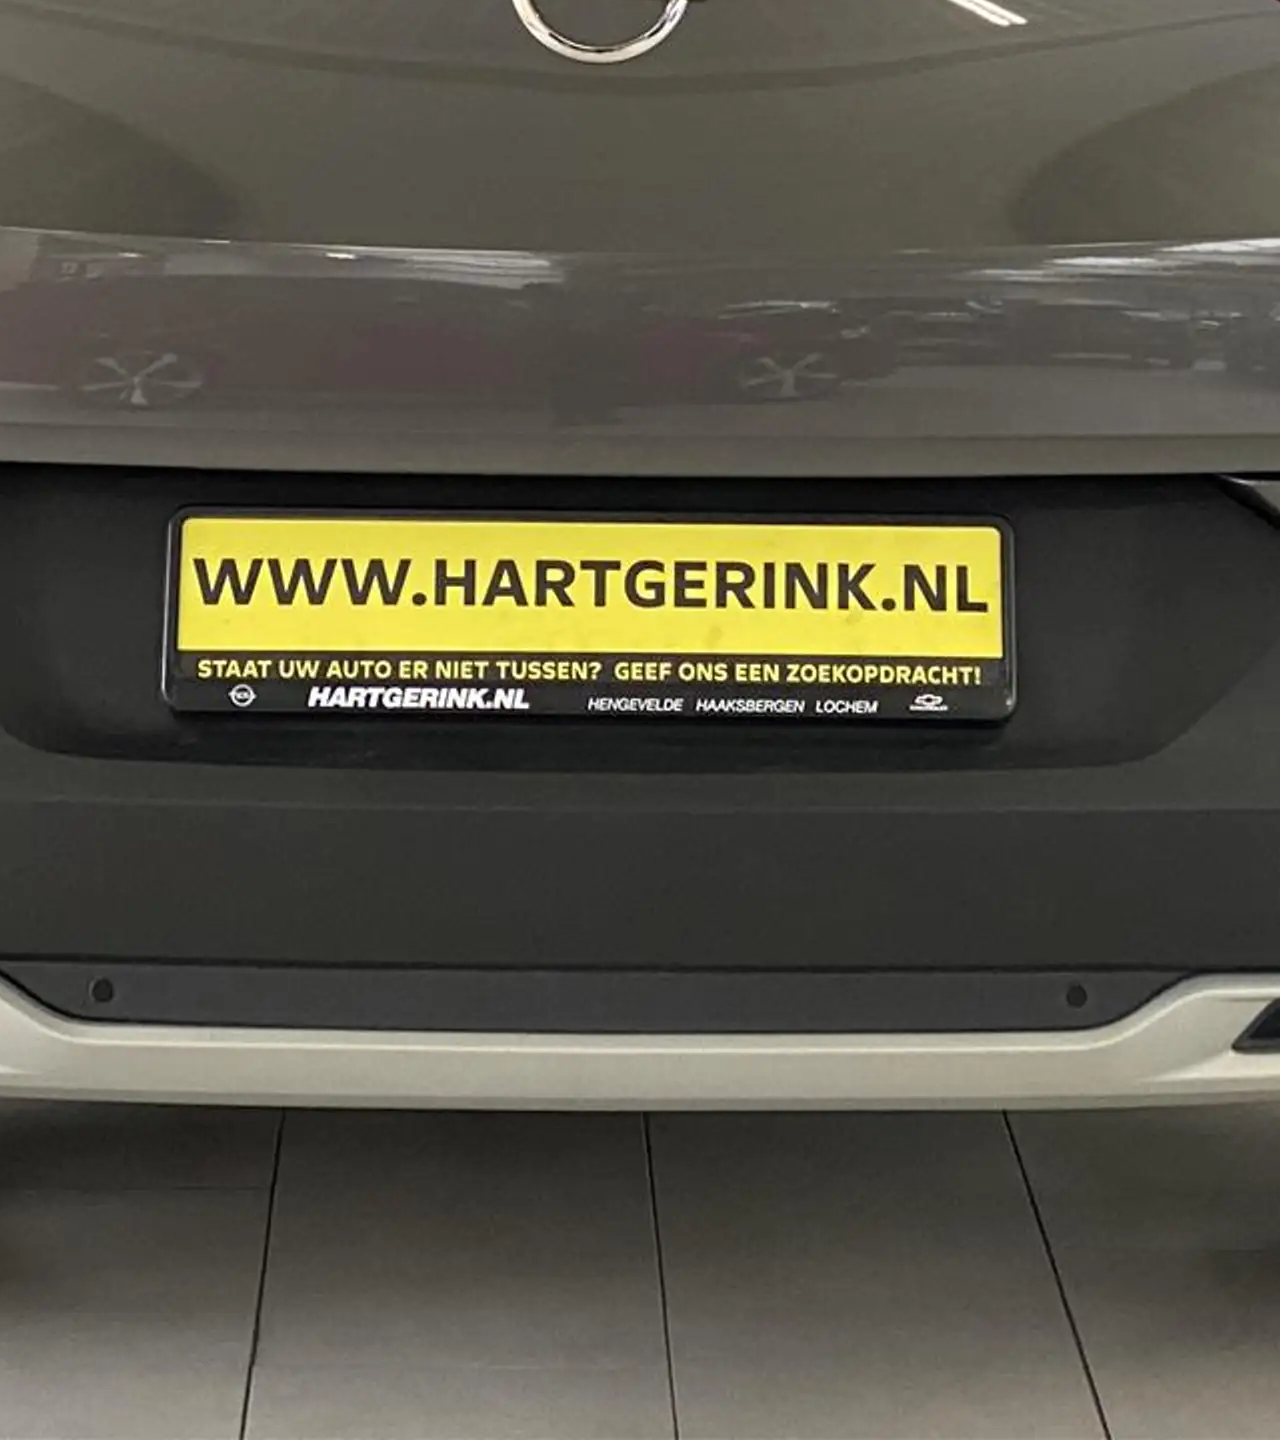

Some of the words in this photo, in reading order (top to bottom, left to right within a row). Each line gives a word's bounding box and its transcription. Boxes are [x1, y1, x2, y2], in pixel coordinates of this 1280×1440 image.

[193, 557, 989, 614] WWW.HARTGERINK.NL
[197, 659, 271, 679] STAAT
[278, 660, 319, 679] UW
[326, 660, 393, 680] AUTO
[398, 661, 428, 680] ER
[435, 661, 489, 680] NIET
[496, 661, 602, 681] TUSSEN?
[614, 662, 672, 682] GEEF
[678, 662, 728, 682] ONS
[735, 663, 779, 683] EEN
[786, 664, 982, 685] ZOEKOPDRACHT!
[307, 685, 531, 710] HARTGERINK.NL
[587, 697, 684, 712] HENGEVELDE
[695, 698, 805, 713] HAAKSBERGEN
[815, 699, 879, 714] LOCHEM
